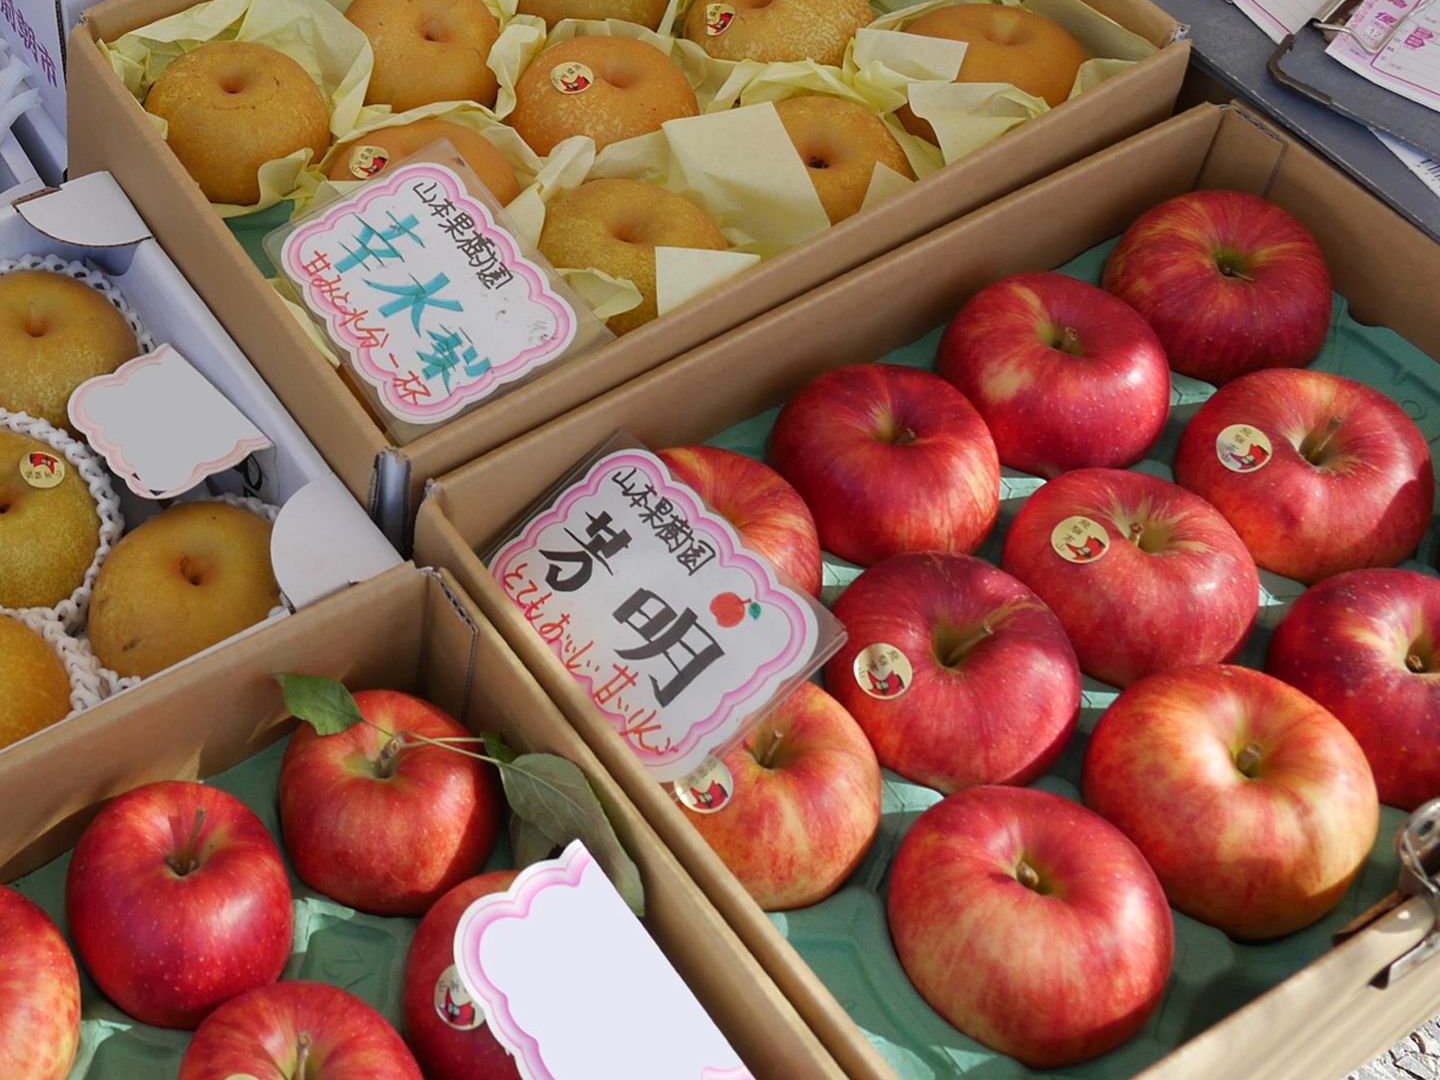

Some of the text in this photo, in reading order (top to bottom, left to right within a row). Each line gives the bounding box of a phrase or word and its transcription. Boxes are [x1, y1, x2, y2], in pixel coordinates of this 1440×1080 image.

[412, 181, 514, 291] 山本果樹園
[611, 467, 717, 577] 山本果樹園
[538, 510, 726, 709] 芳明
